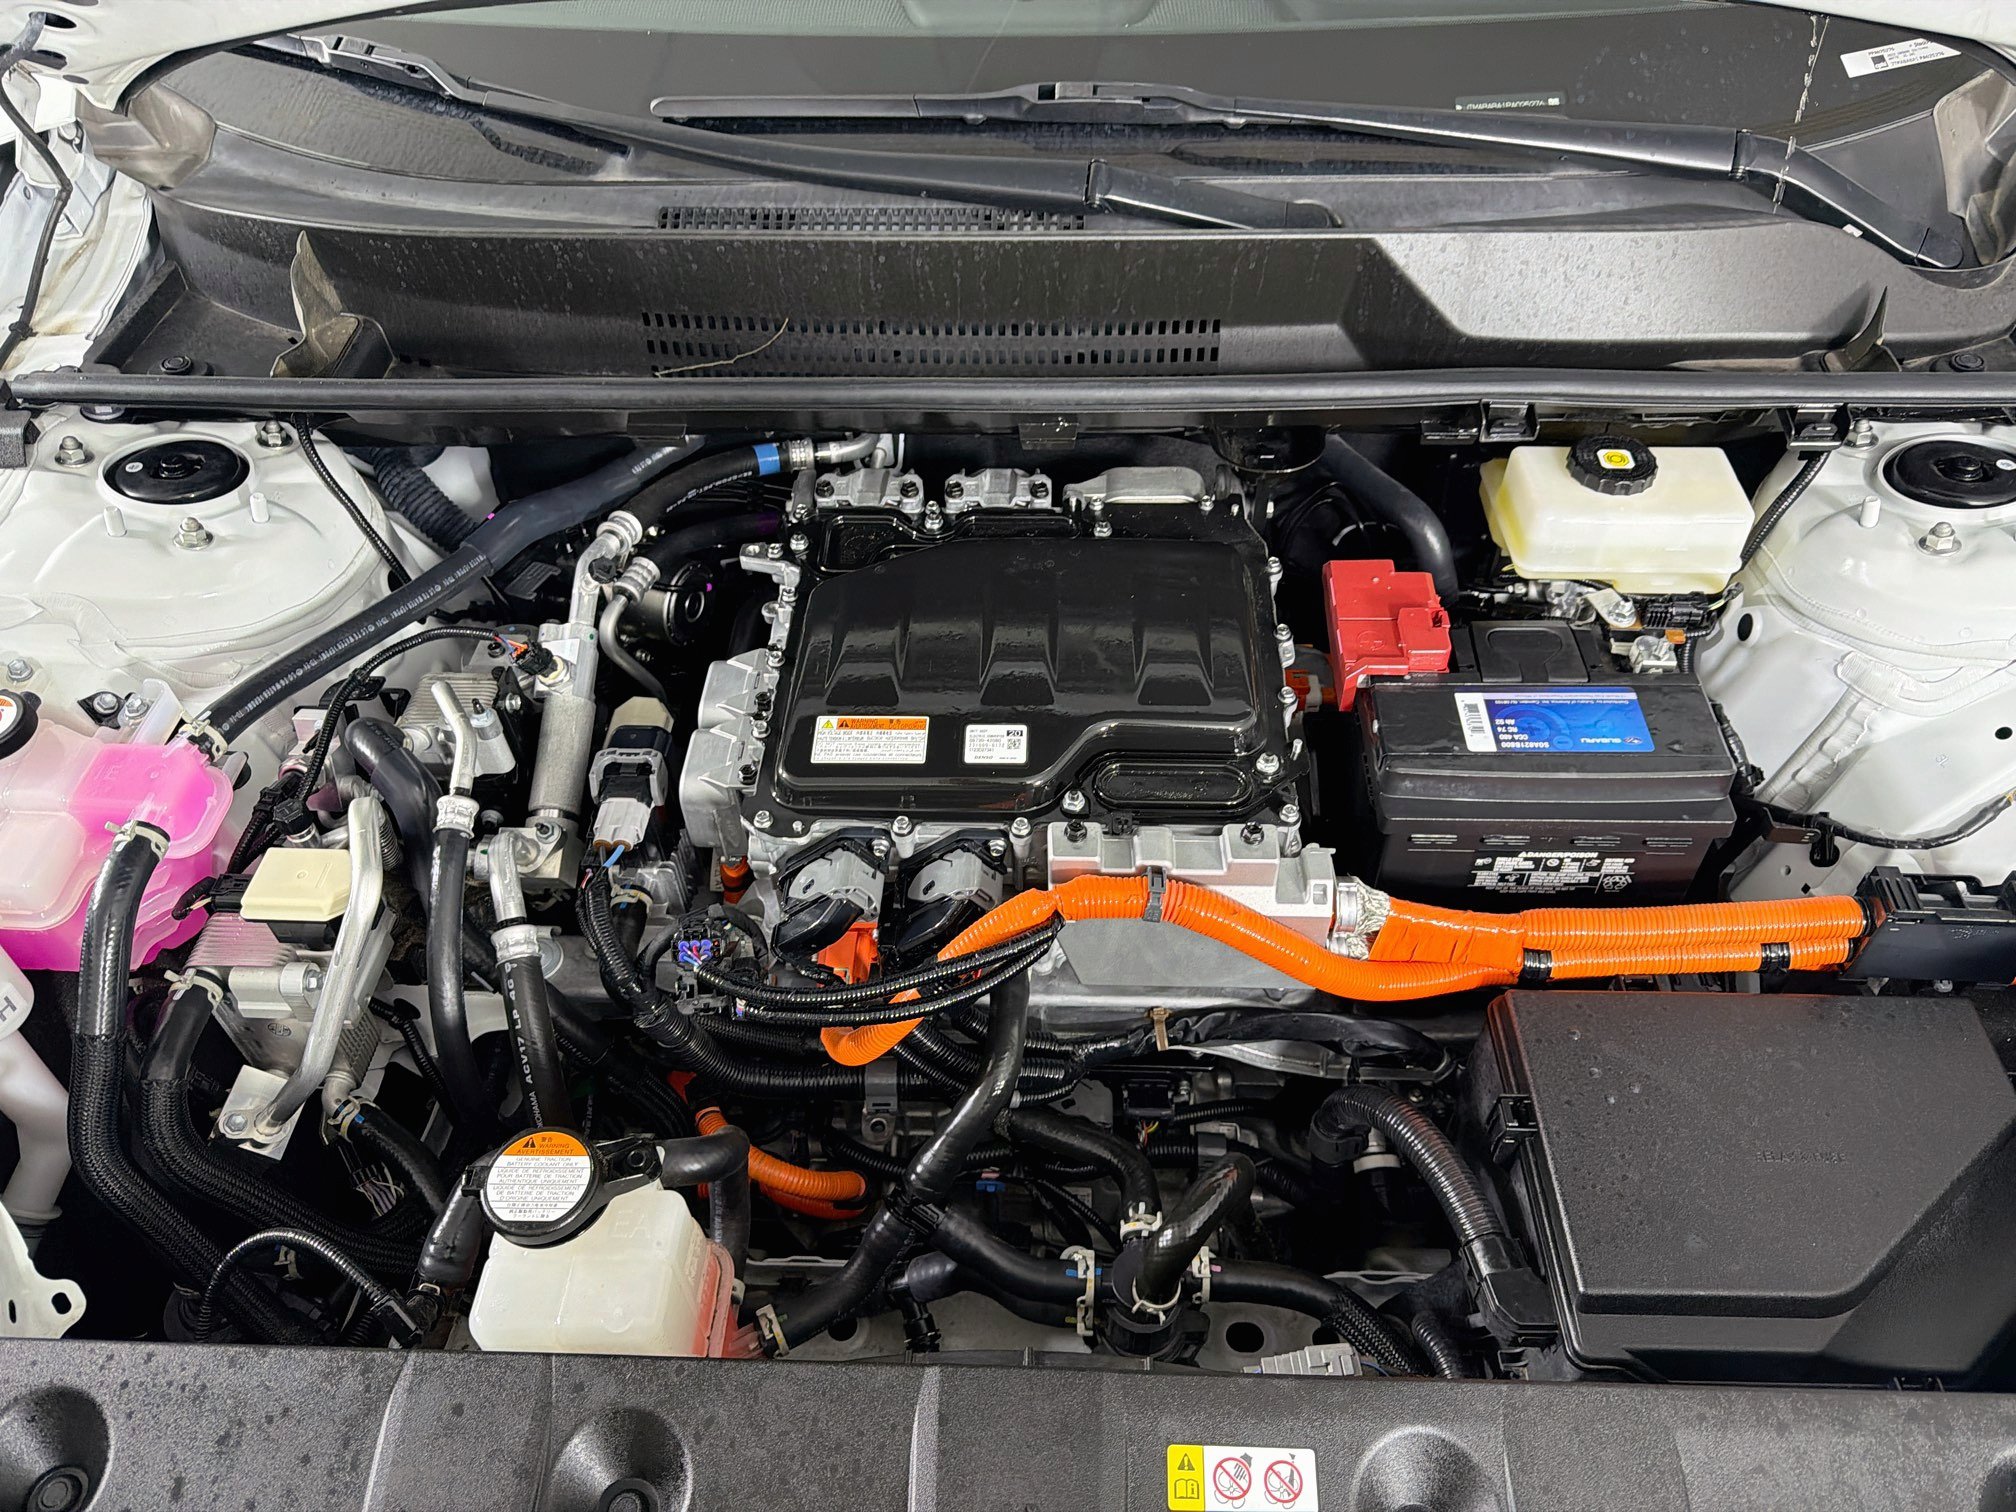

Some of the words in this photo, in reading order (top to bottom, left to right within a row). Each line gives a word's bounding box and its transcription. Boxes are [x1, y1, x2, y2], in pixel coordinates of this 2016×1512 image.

[512, 1009, 522, 1030] LP
[517, 1037, 533, 1085] ACV17
[530, 1091, 544, 1129] KOHAMA
